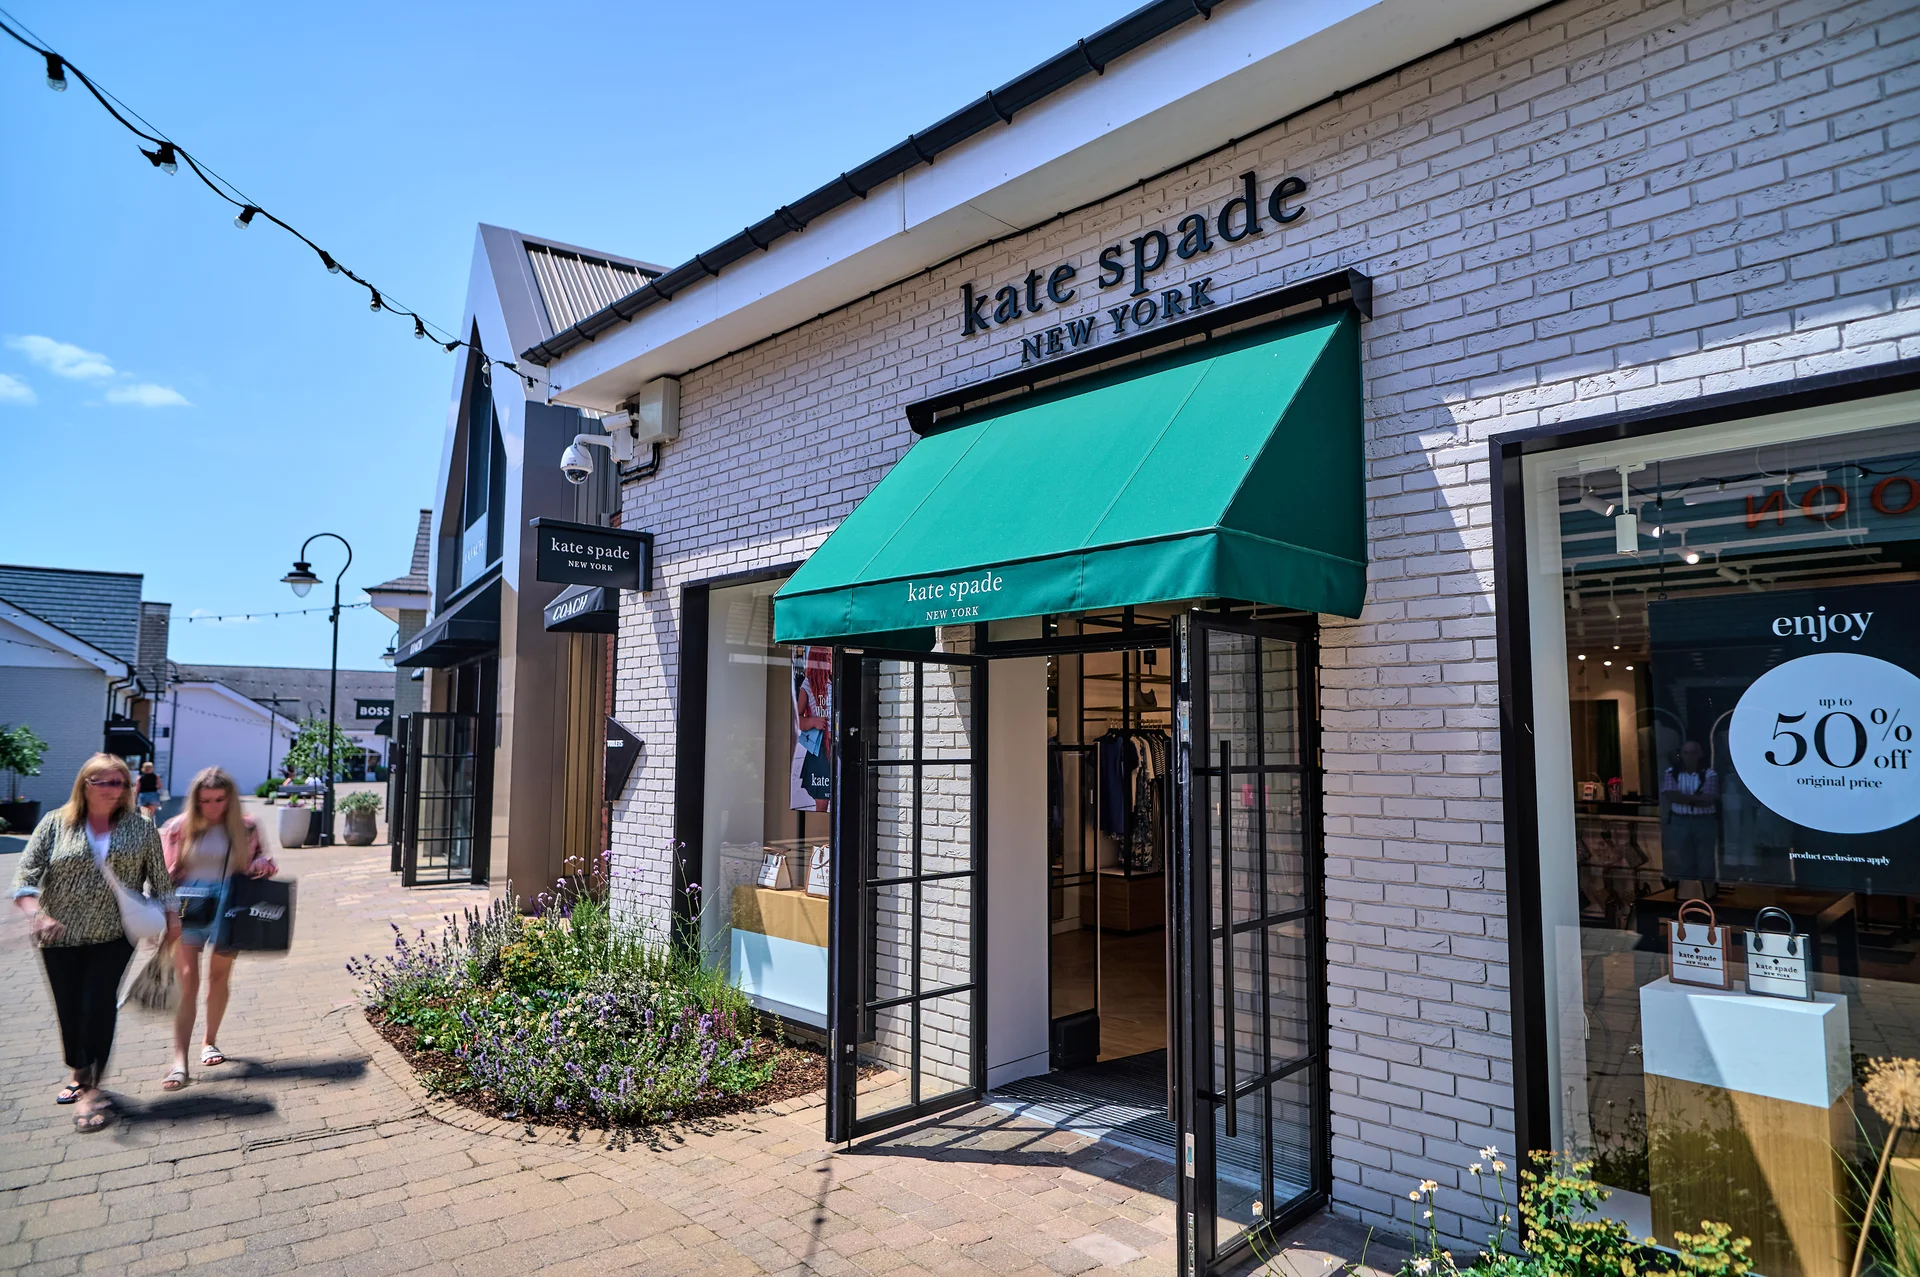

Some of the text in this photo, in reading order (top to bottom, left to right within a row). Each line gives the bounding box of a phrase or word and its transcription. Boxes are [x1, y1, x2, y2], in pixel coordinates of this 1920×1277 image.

[960, 170, 1307, 337] kate spade
[1020, 277, 1216, 364] NEW YORK
[551, 537, 630, 560] kate spade
[568, 559, 614, 572] NEW YORK
[907, 571, 1003, 602] kate spade
[552, 593, 589, 621] COACH
[926, 605, 979, 620] NEW YORK
[1771, 605, 1874, 643] enjoy
[1819, 696, 1853, 708] up to
[360, 706, 390, 716] BOSS
[1873, 748, 1912, 770] off
[811, 773, 830, 787] kate
[1796, 775, 1883, 790] original price
[1788, 851, 1891, 867] product exclusions apply
[1678, 951, 1717, 962] kate spade
[1755, 962, 1799, 974] kate spade
